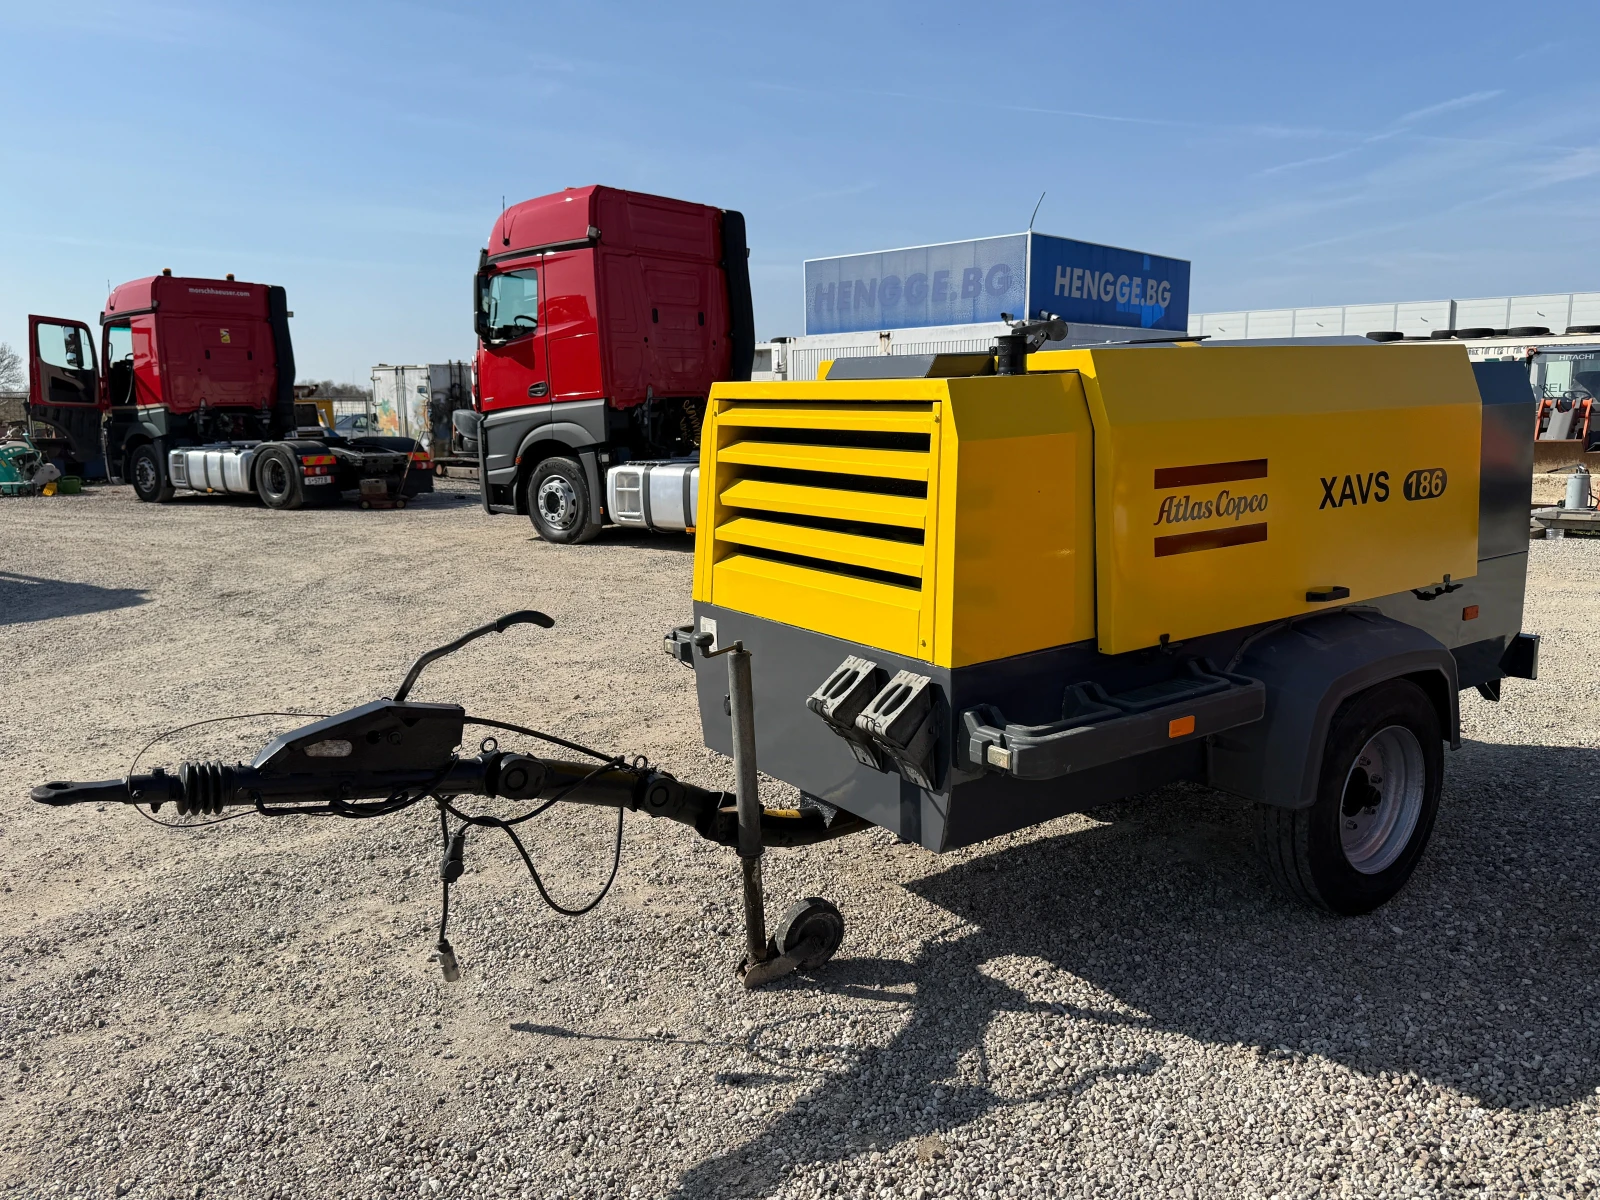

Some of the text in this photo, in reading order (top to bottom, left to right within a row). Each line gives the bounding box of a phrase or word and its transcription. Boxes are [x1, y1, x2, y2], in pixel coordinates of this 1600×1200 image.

[188, 287, 250, 297] morschhaeuser.com
[814, 263, 1012, 312] HENGGE.BG
[1054, 265, 1172, 308] HENGGE.BG
[1559, 353, 1595, 361] HITACHI
[1153, 489, 1269, 526] Atlas Copco
[1319, 470, 1443, 510] XAVS 186
